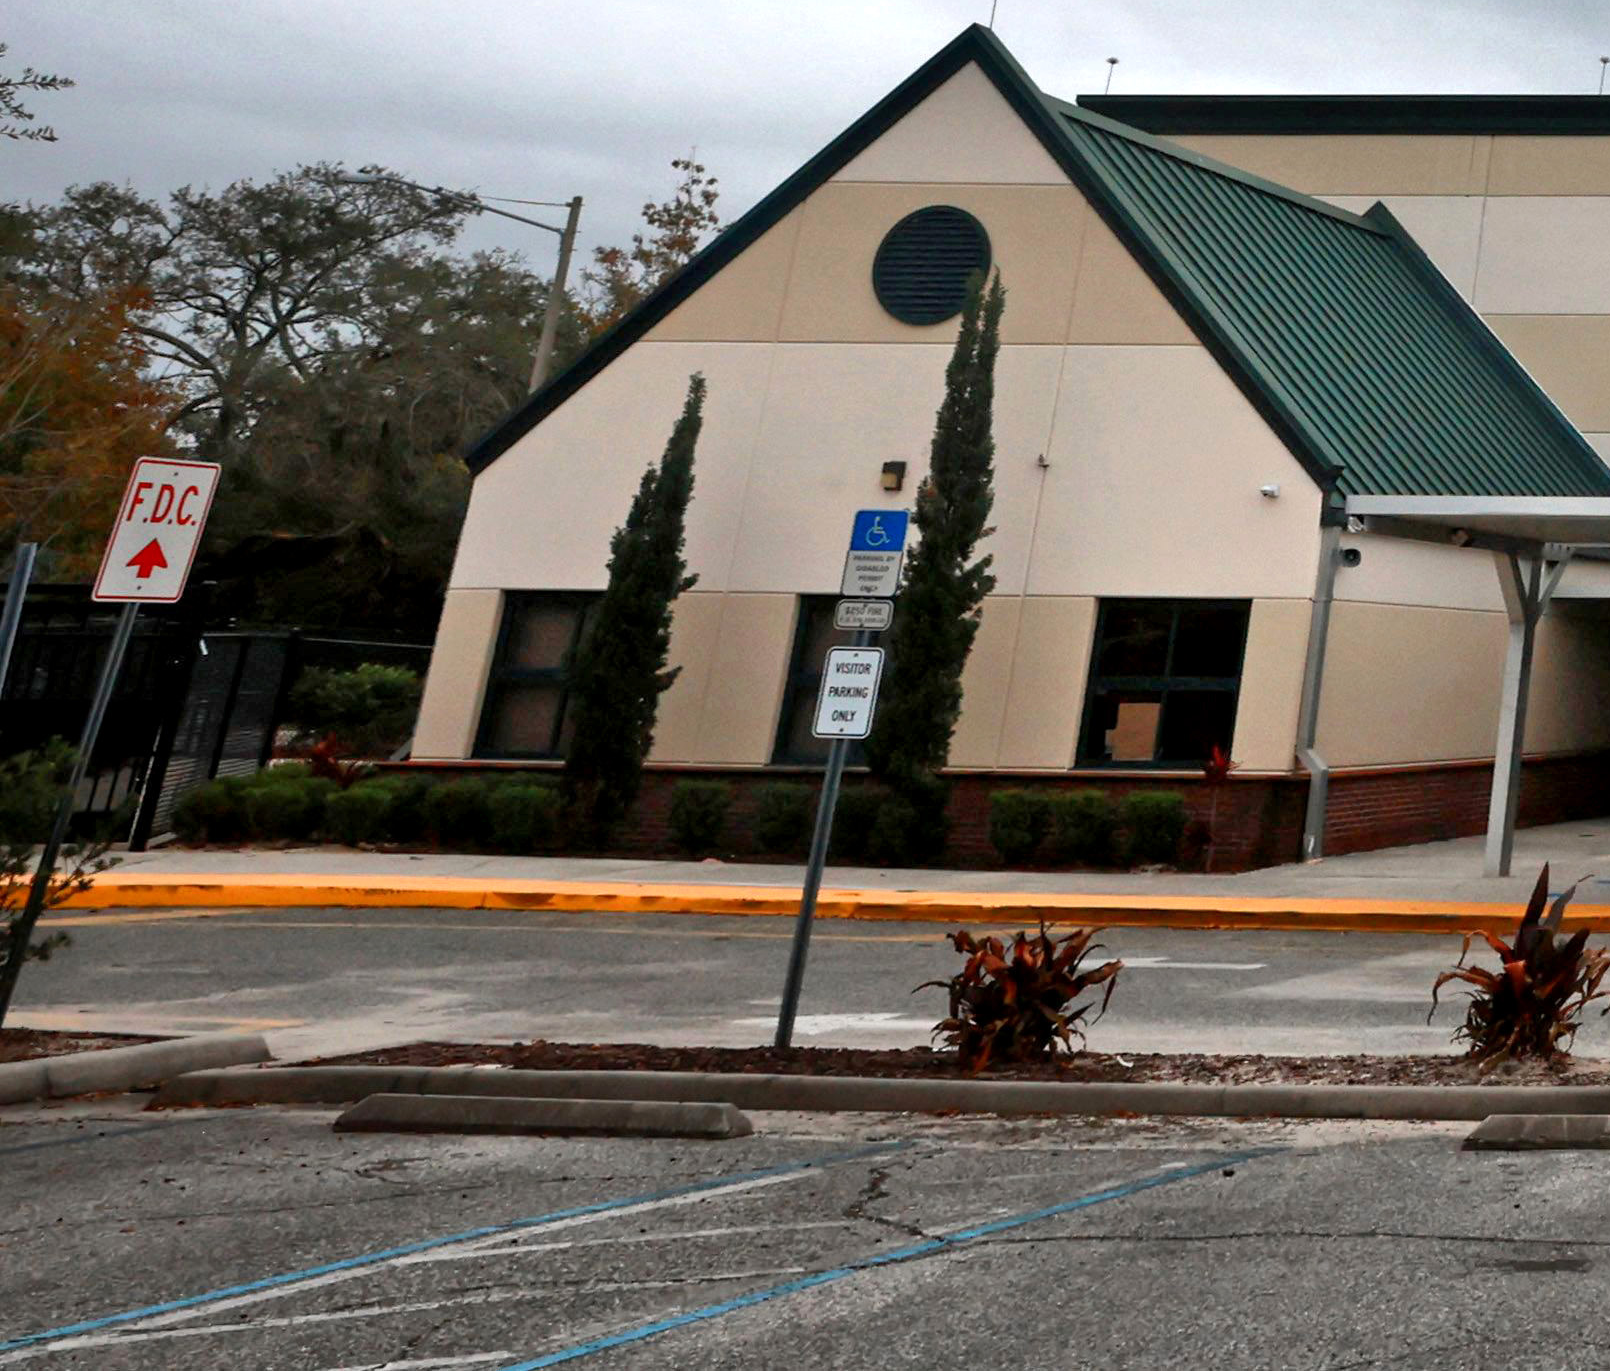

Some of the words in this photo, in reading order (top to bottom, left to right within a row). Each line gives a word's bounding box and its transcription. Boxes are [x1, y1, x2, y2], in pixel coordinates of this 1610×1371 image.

[125, 482, 199, 526] F.D.C.
[836, 663, 872, 674] VISITOR
[828, 686, 869, 698] PARKING
[831, 710, 857, 722] ONLY
